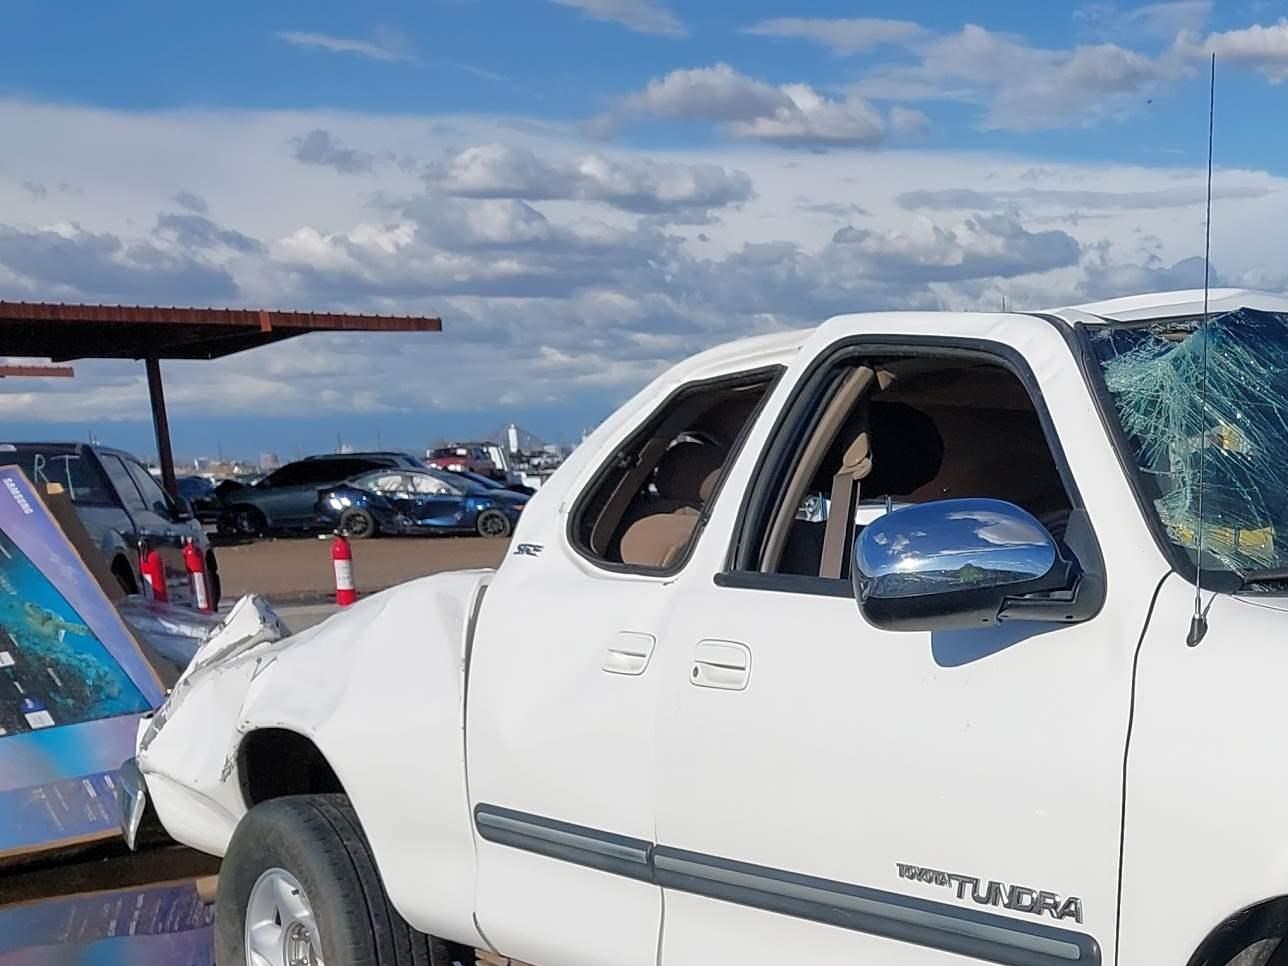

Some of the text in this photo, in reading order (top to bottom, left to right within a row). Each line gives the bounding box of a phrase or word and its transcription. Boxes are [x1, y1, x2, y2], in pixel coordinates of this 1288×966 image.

[3, 477, 34, 514] SAMSUNG
[896, 862, 1084, 925] TOYOTA TUNDRA
